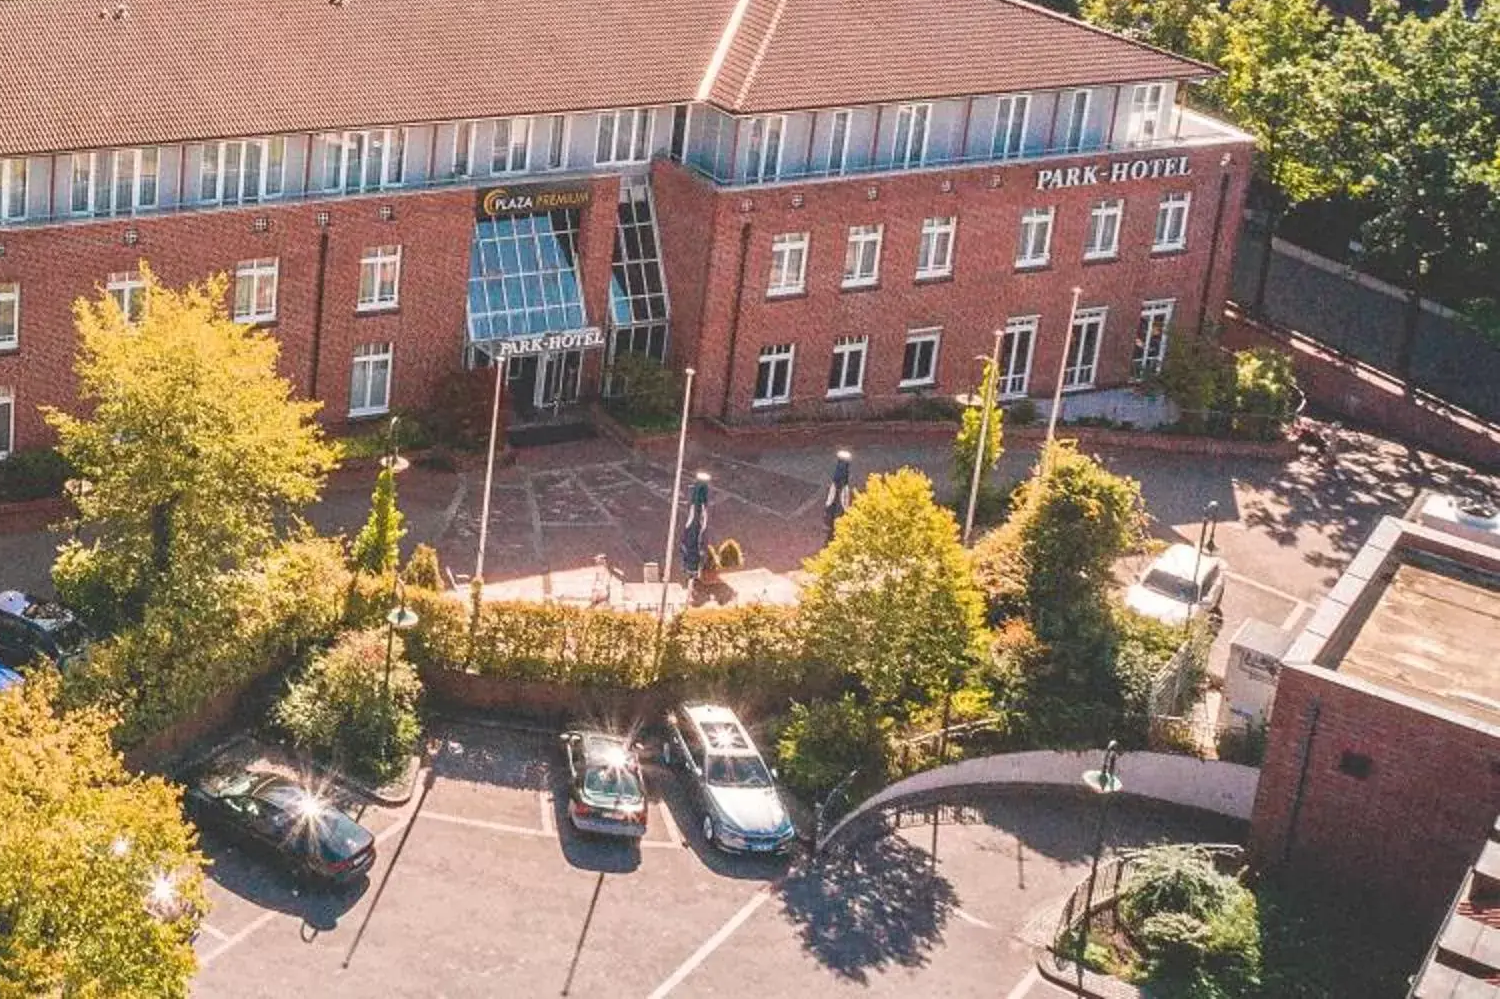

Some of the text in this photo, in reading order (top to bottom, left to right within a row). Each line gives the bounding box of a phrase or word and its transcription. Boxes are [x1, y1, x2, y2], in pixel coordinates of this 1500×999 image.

[1035, 155, 1193, 191] PARK-HOTEL
[495, 191, 590, 211] PLAZA PREMIUM
[499, 330, 605, 356] PARK-HOTEL
